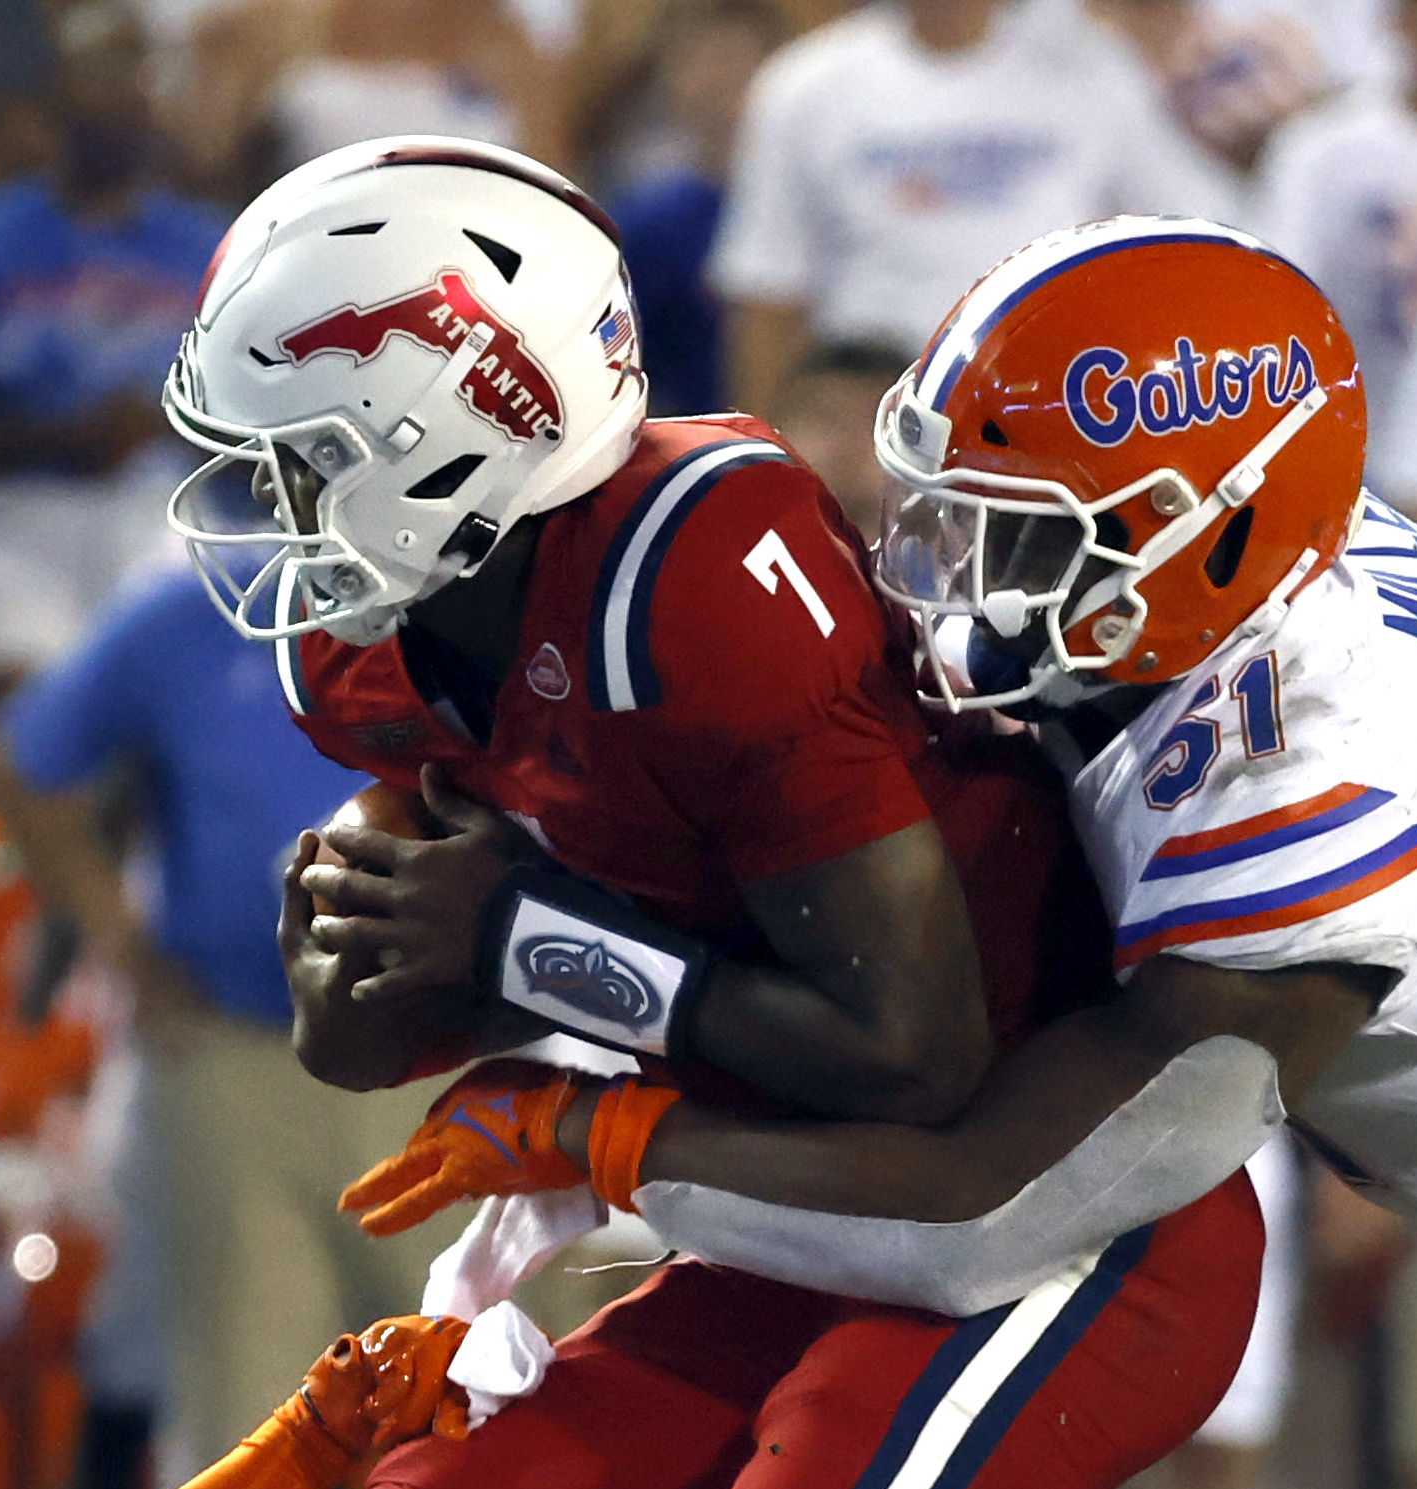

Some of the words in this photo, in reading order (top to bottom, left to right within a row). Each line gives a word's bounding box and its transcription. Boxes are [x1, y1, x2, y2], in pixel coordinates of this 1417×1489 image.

[427, 302, 555, 434] ATANTIC
[1063, 335, 1319, 448] Gators
[742, 529, 836, 638] 7
[1141, 650, 1286, 812] 51
